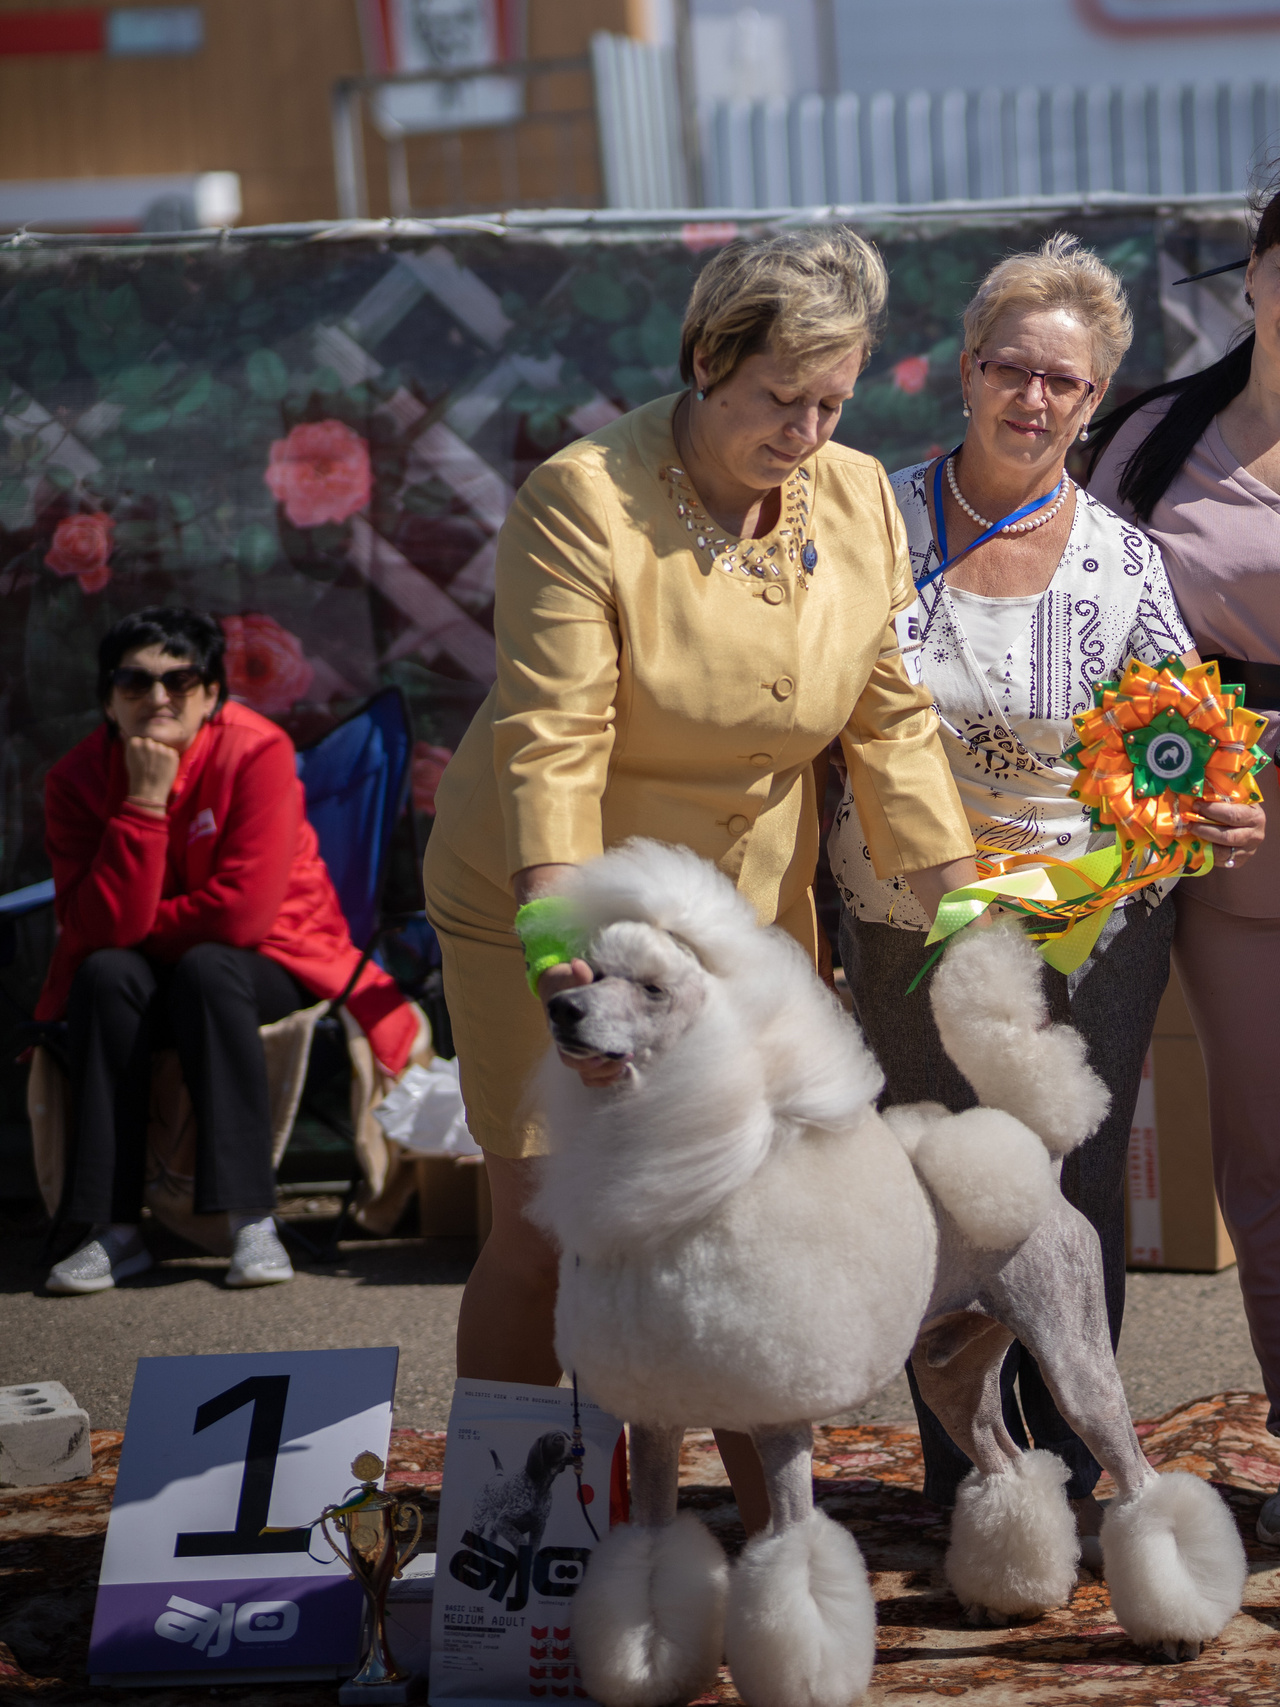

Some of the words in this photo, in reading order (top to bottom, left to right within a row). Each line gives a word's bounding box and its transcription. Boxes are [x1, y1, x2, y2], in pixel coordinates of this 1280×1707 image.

[173, 1374, 312, 1558] 1
[445, 1604, 465, 1613] BASIC
[469, 1605, 484, 1614] LINE
[443, 1613, 484, 1625] MEDIUM
[491, 1616, 527, 1627] ADULT
